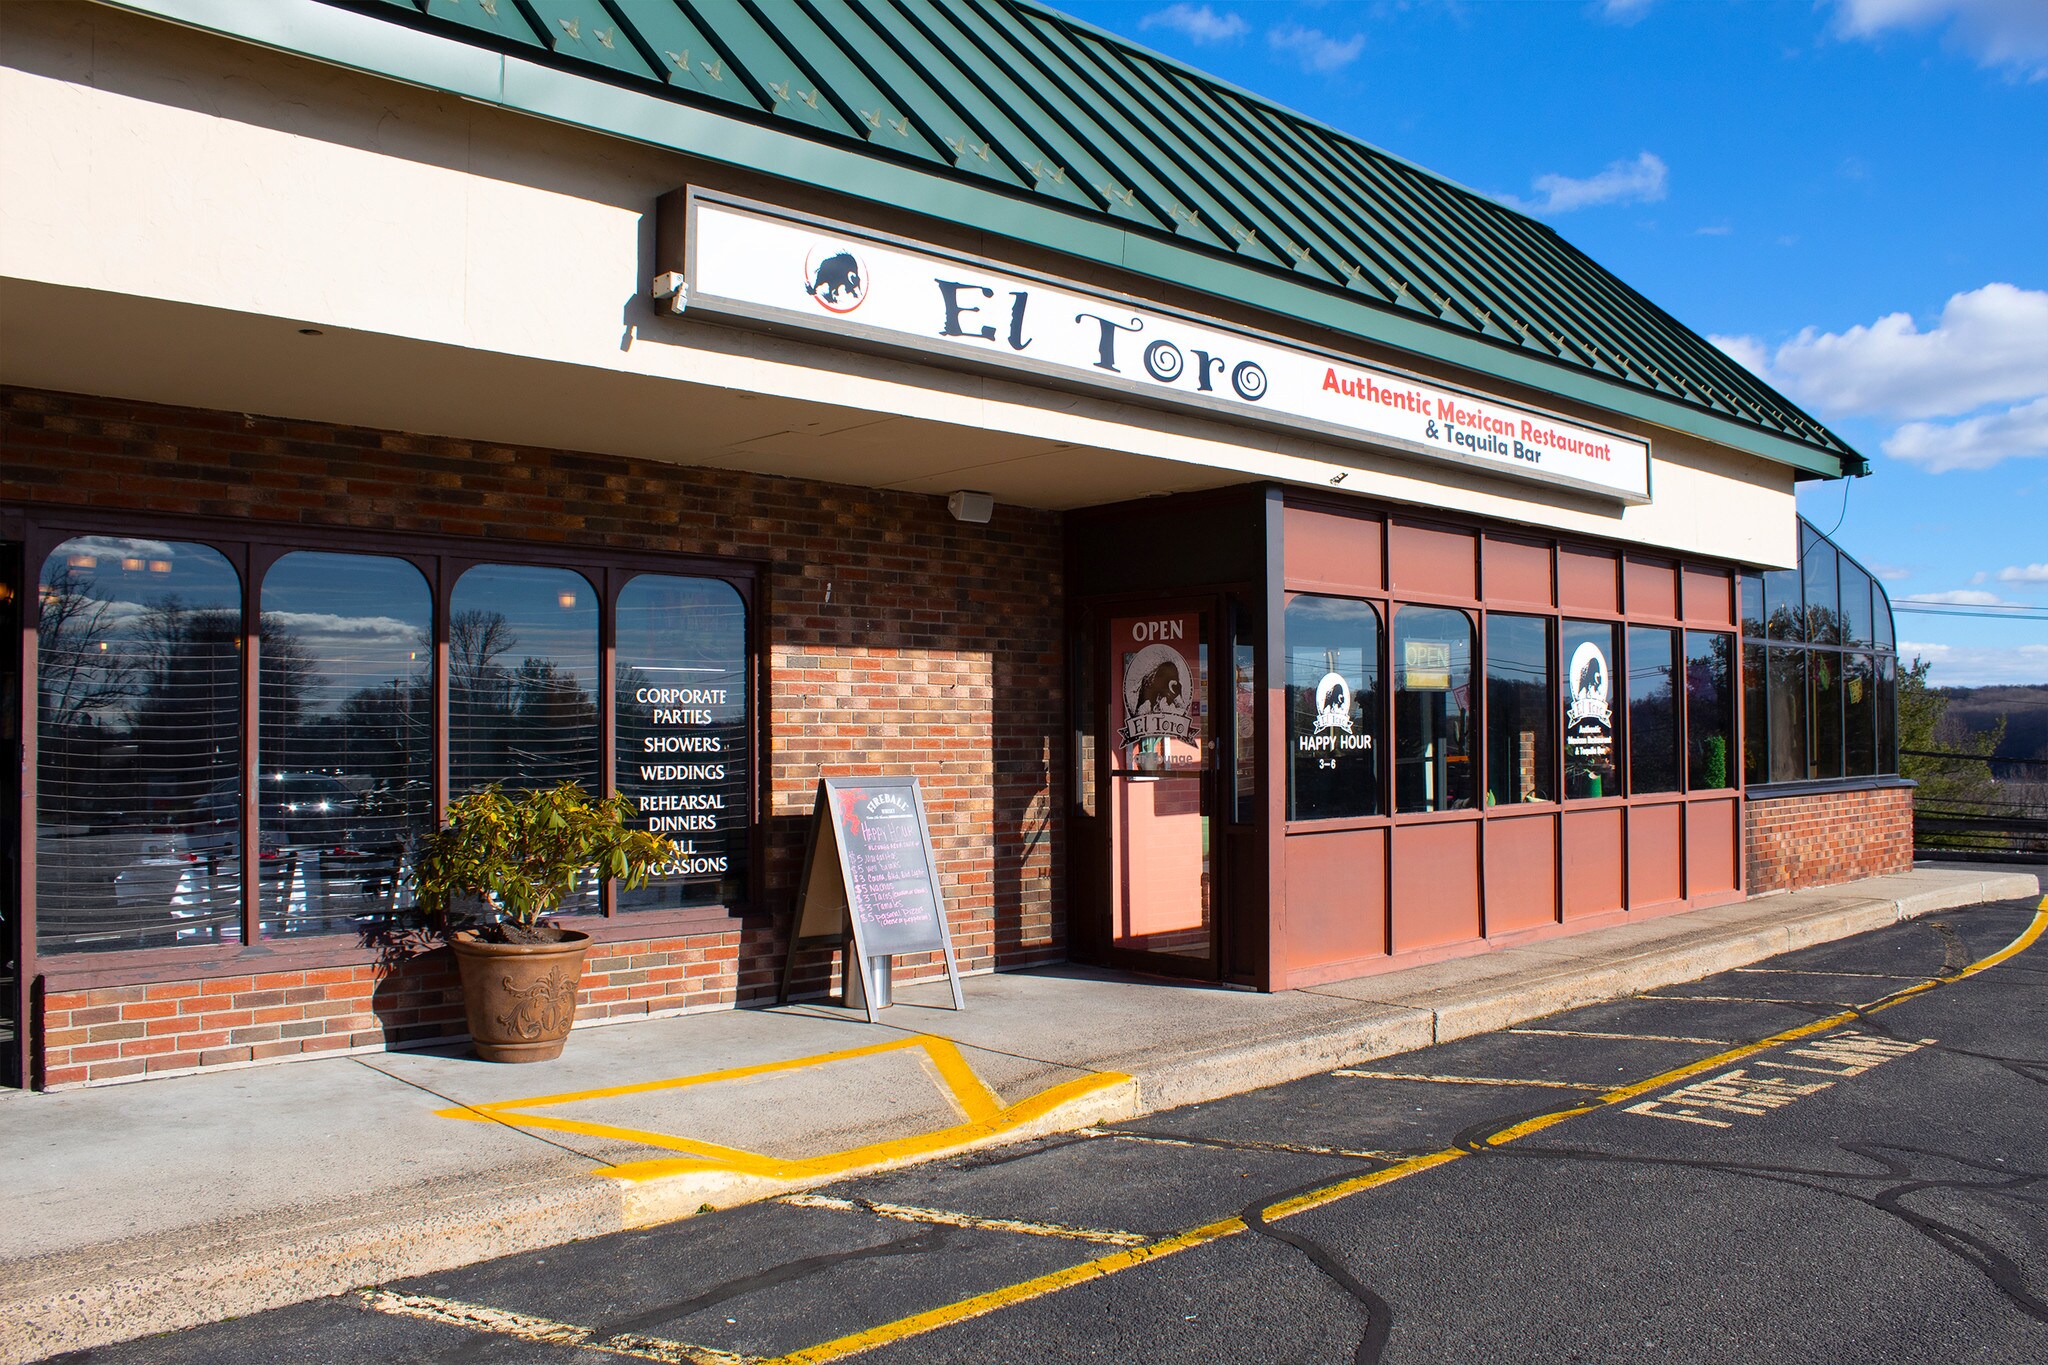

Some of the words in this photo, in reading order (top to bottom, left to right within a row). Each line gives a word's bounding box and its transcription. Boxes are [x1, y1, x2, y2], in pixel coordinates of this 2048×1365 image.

[934, 278, 1033, 351] El
[1075, 313, 1268, 401] Toro
[1322, 367, 1432, 416] Authentic
[1437, 398, 1516, 437] Mexican
[1521, 420, 1611, 462] Restaurant
[1425, 419, 1439, 439] &
[1444, 423, 1508, 456] Tequila
[1514, 440, 1541, 463] Bar
[1132, 619, 1183, 641] OPEN
[1406, 646, 1449, 668] OPEN
[636, 688, 727, 704] CORPORATE
[653, 709, 712, 725] PARTIES
[1133, 716, 1149, 734] El
[1152, 714, 1185, 734] Toro
[644, 737, 721, 753] SHOWERS
[1300, 735, 1337, 751] HAPPY
[1340, 734, 1372, 750] HOUR
[640, 765, 725, 781] WEDDINGS
[640, 795, 725, 811] REHEARSAL
[866, 793, 908, 813] FIREBALL
[649, 815, 717, 832] DINNERS
[668, 839, 697, 856] ALL
[641, 857, 728, 876] CCASIONS
[1622, 1069, 1836, 1129] FIRE
